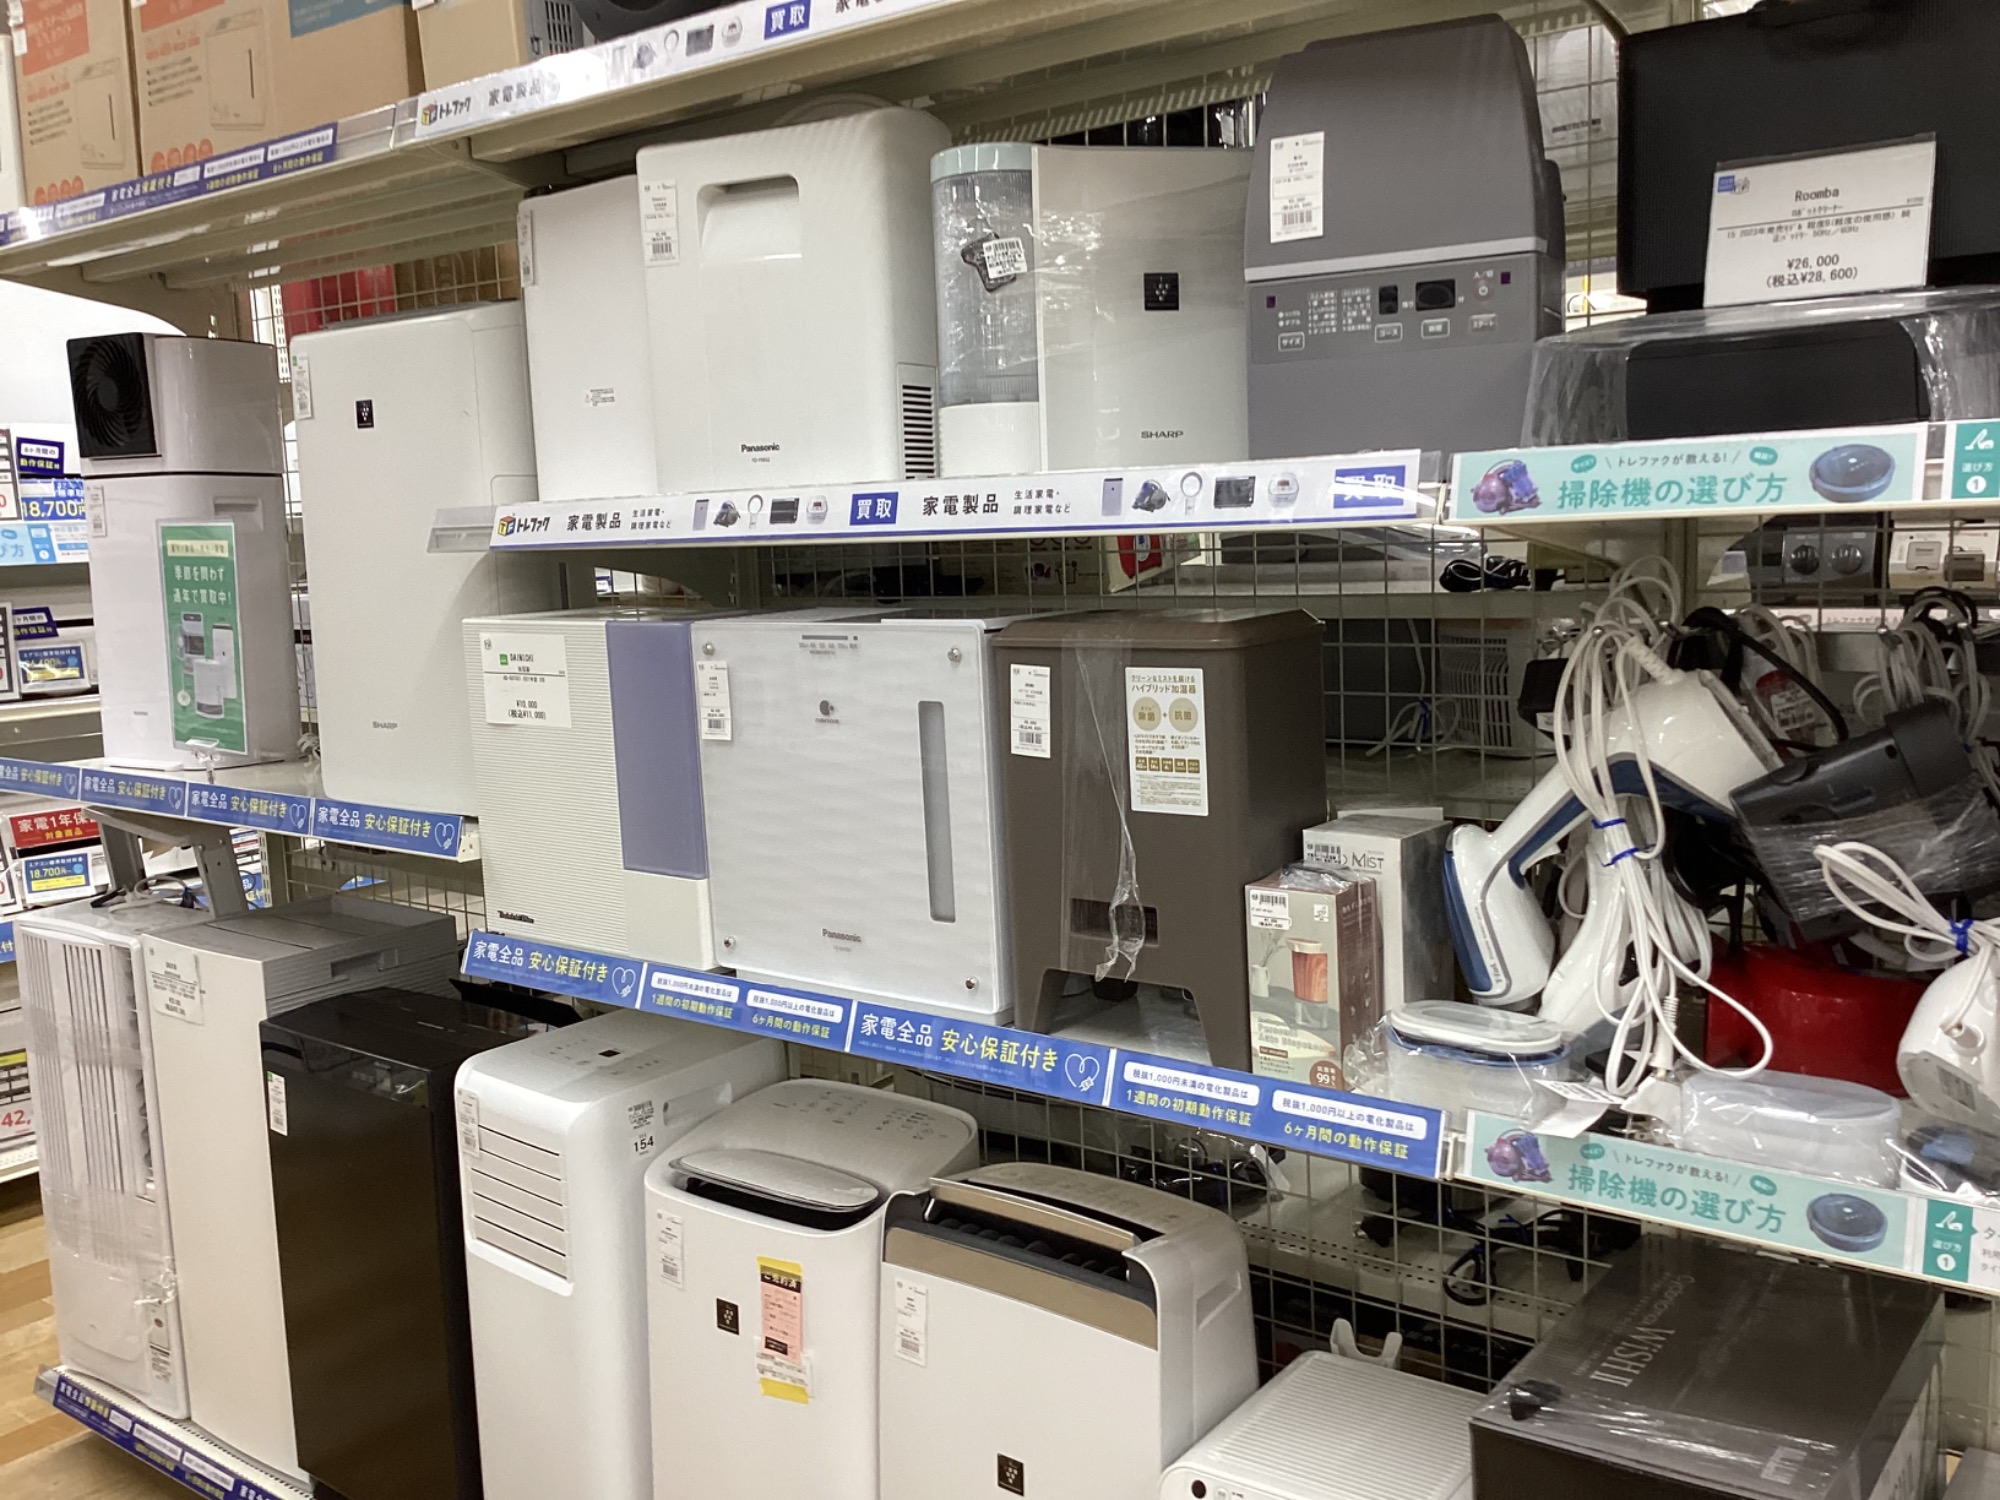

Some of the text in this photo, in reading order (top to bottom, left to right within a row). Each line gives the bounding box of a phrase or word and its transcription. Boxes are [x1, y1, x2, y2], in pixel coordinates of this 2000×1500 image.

[771, 6, 804, 32] 買取
[438, 80, 542, 119] トレファク 家電製品
[1795, 187, 1840, 203] Roomba
[741, 442, 780, 453] Panasonic
[1140, 430, 1184, 440] SHARP
[1961, 462, 1994, 473] 選び方
[1557, 472, 1788, 510] 掃除機の選び方
[855, 498, 892, 520] 買取
[922, 493, 1000, 517] 家電製品
[517, 516, 551, 532] トレファク
[566, 512, 622, 531] 家電製品
[1131, 684, 1196, 695] ハイブリッド加湿器
[372, 721, 398, 730] SHARP
[20, 768, 63, 787] 安心保証付き
[83, 776, 167, 801] 家電全品 安心保証付き
[190, 789, 288, 819] 家電全品 安心保証付き
[17, 811, 97, 833] 家電1年保
[317, 806, 432, 839] 家電全品 安心保証付き
[1352, 851, 1385, 871] MIST
[822, 928, 862, 942] Panasonic
[472, 940, 609, 984] 家電全品 安心保証付き
[650, 993, 733, 1020] 1週間の初期動作保証
[752, 1013, 830, 1040] 6ヶ月間の動作保証
[860, 1013, 933, 1048] 家電全品
[941, 1028, 1059, 1072] 安心保証付き
[1132, 1067, 1249, 1099] 税抜1,000円未満の電化製品は
[1125, 1087, 1252, 1127] 1週間の初期動作保証
[1281, 1096, 1415, 1132] 税抜1,000円以上の電化製品は
[633, 1135, 655, 1152] 154
[1283, 1120, 1410, 1160] 6ヶ月間の動作保証
[1566, 1162, 1787, 1234] 掃除機の選び方
[1932, 1239, 1963, 1253] 選び方
